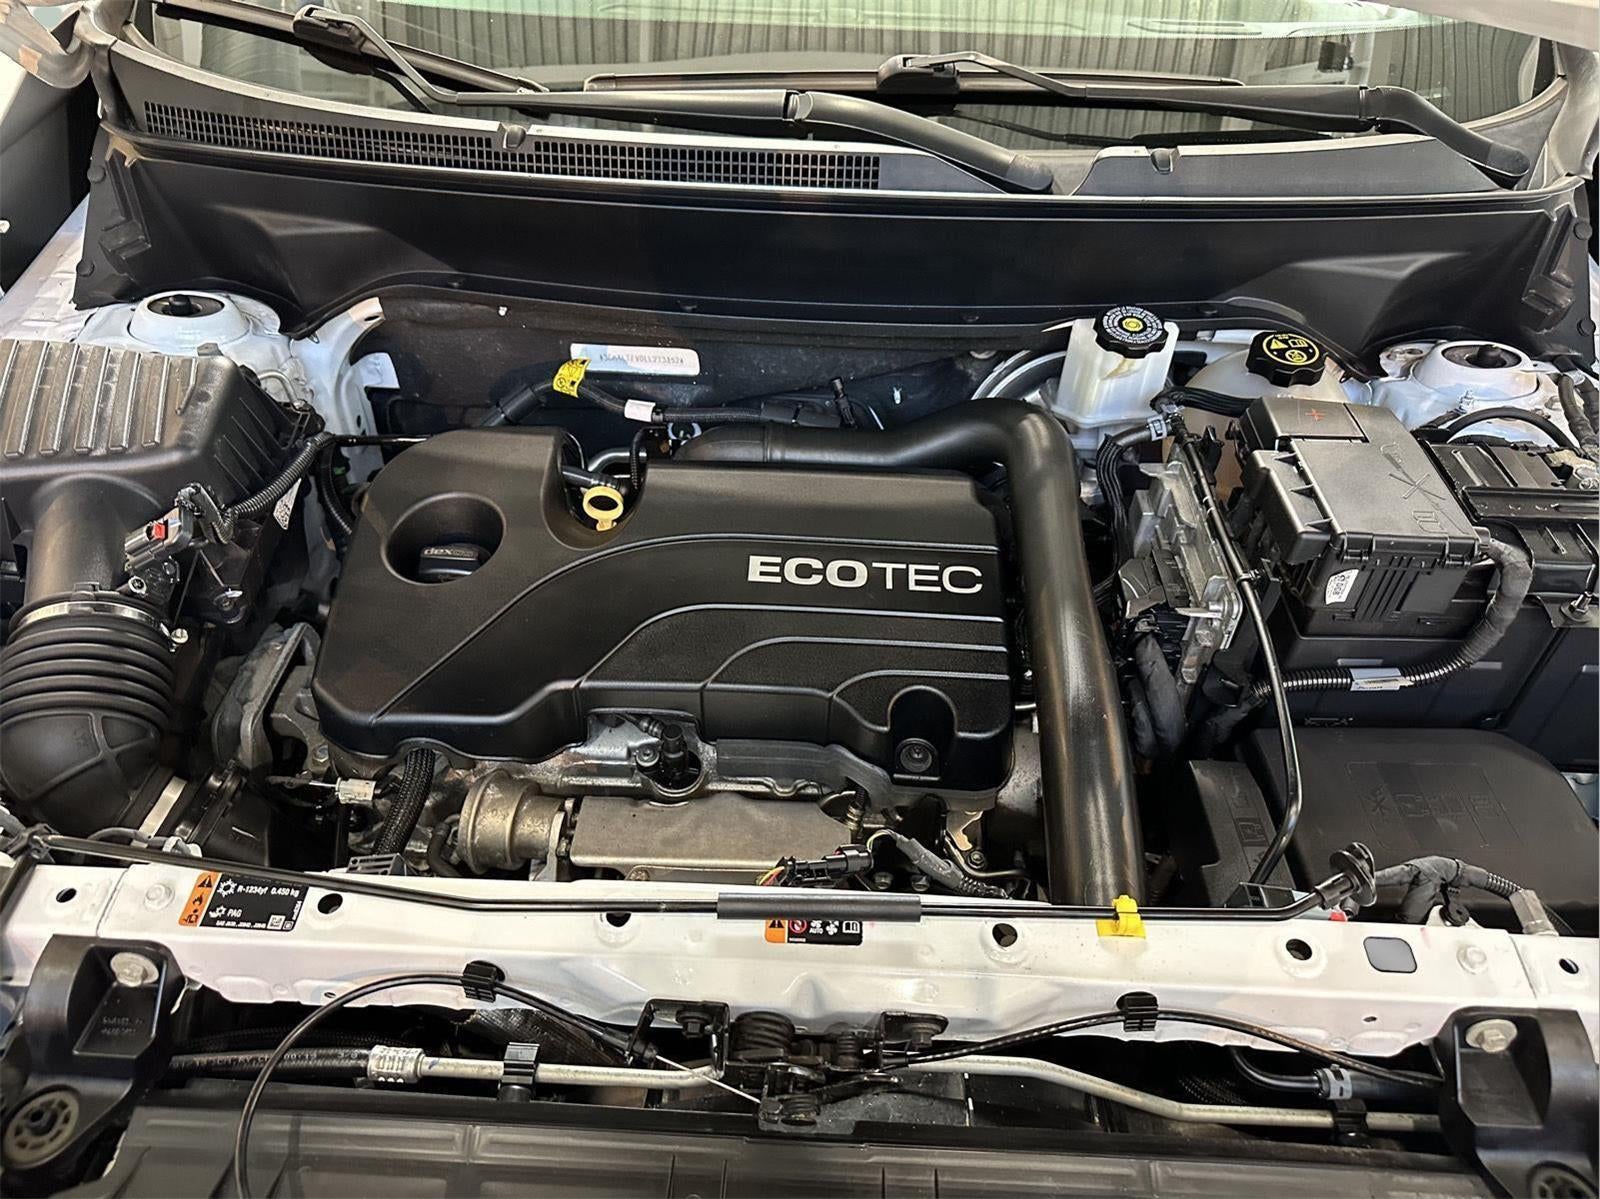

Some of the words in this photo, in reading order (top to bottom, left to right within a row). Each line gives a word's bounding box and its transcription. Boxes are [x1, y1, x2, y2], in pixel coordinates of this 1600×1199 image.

[747, 555, 983, 595] ECOTEC
[237, 885, 268, 896] R-1234yf
[271, 887, 290, 896] 0.450
[290, 888, 300, 898] kg
[227, 909, 242, 917] PAG
